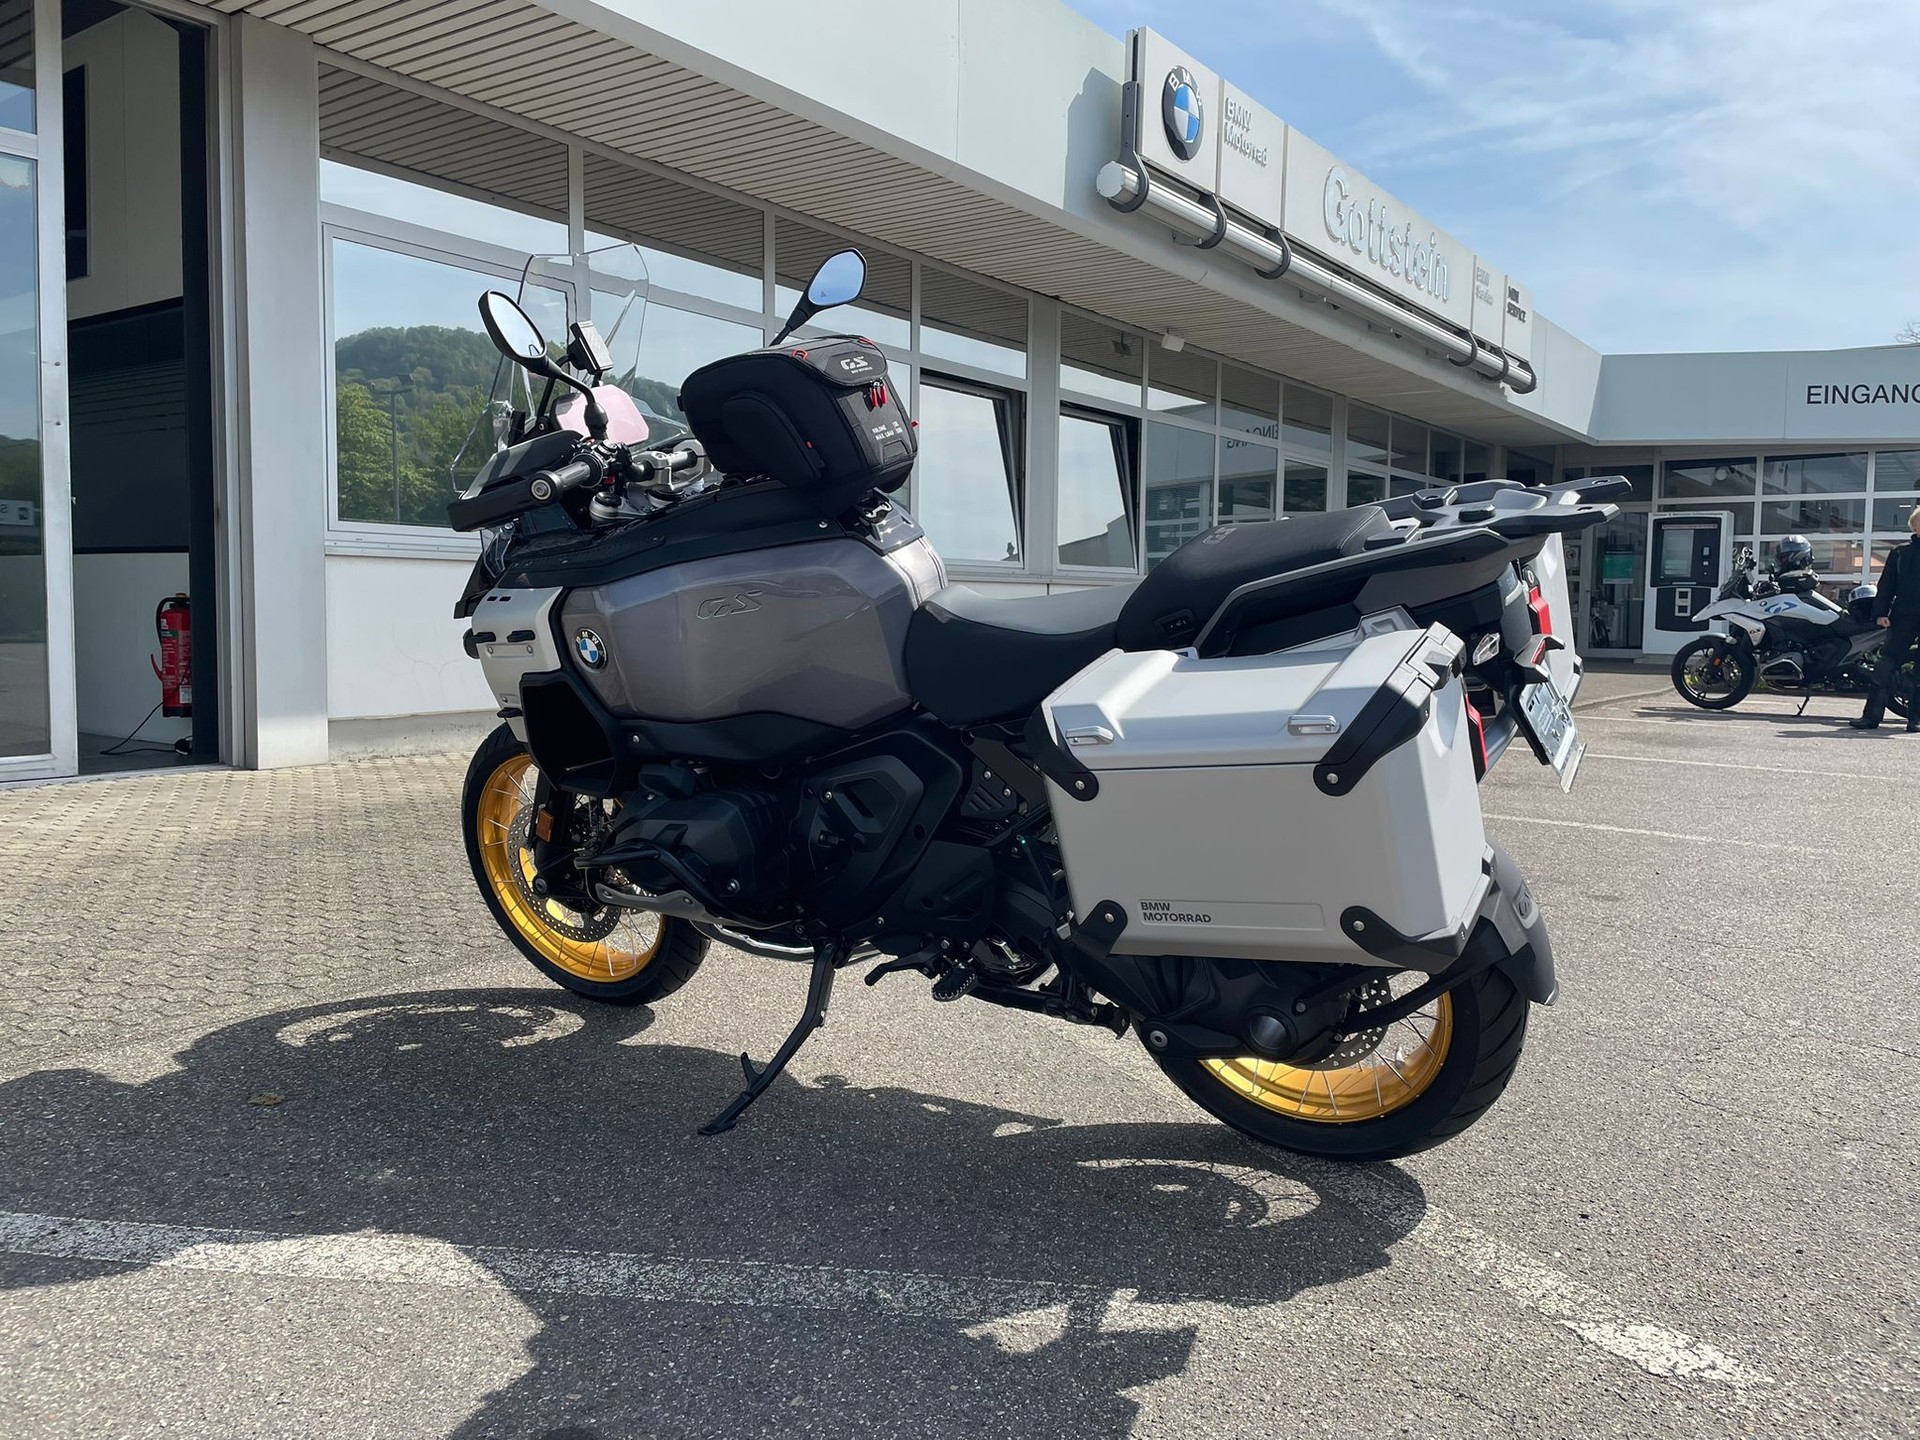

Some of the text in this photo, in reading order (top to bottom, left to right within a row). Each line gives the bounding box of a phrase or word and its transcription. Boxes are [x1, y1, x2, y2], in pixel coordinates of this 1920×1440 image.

[1225, 97, 1252, 132] BMW
[1223, 121, 1268, 167] Motorrad
[1322, 165, 1449, 303] Gottstein
[1141, 902, 1170, 911] BMW
[1143, 912, 1211, 923] MOTORRAD
